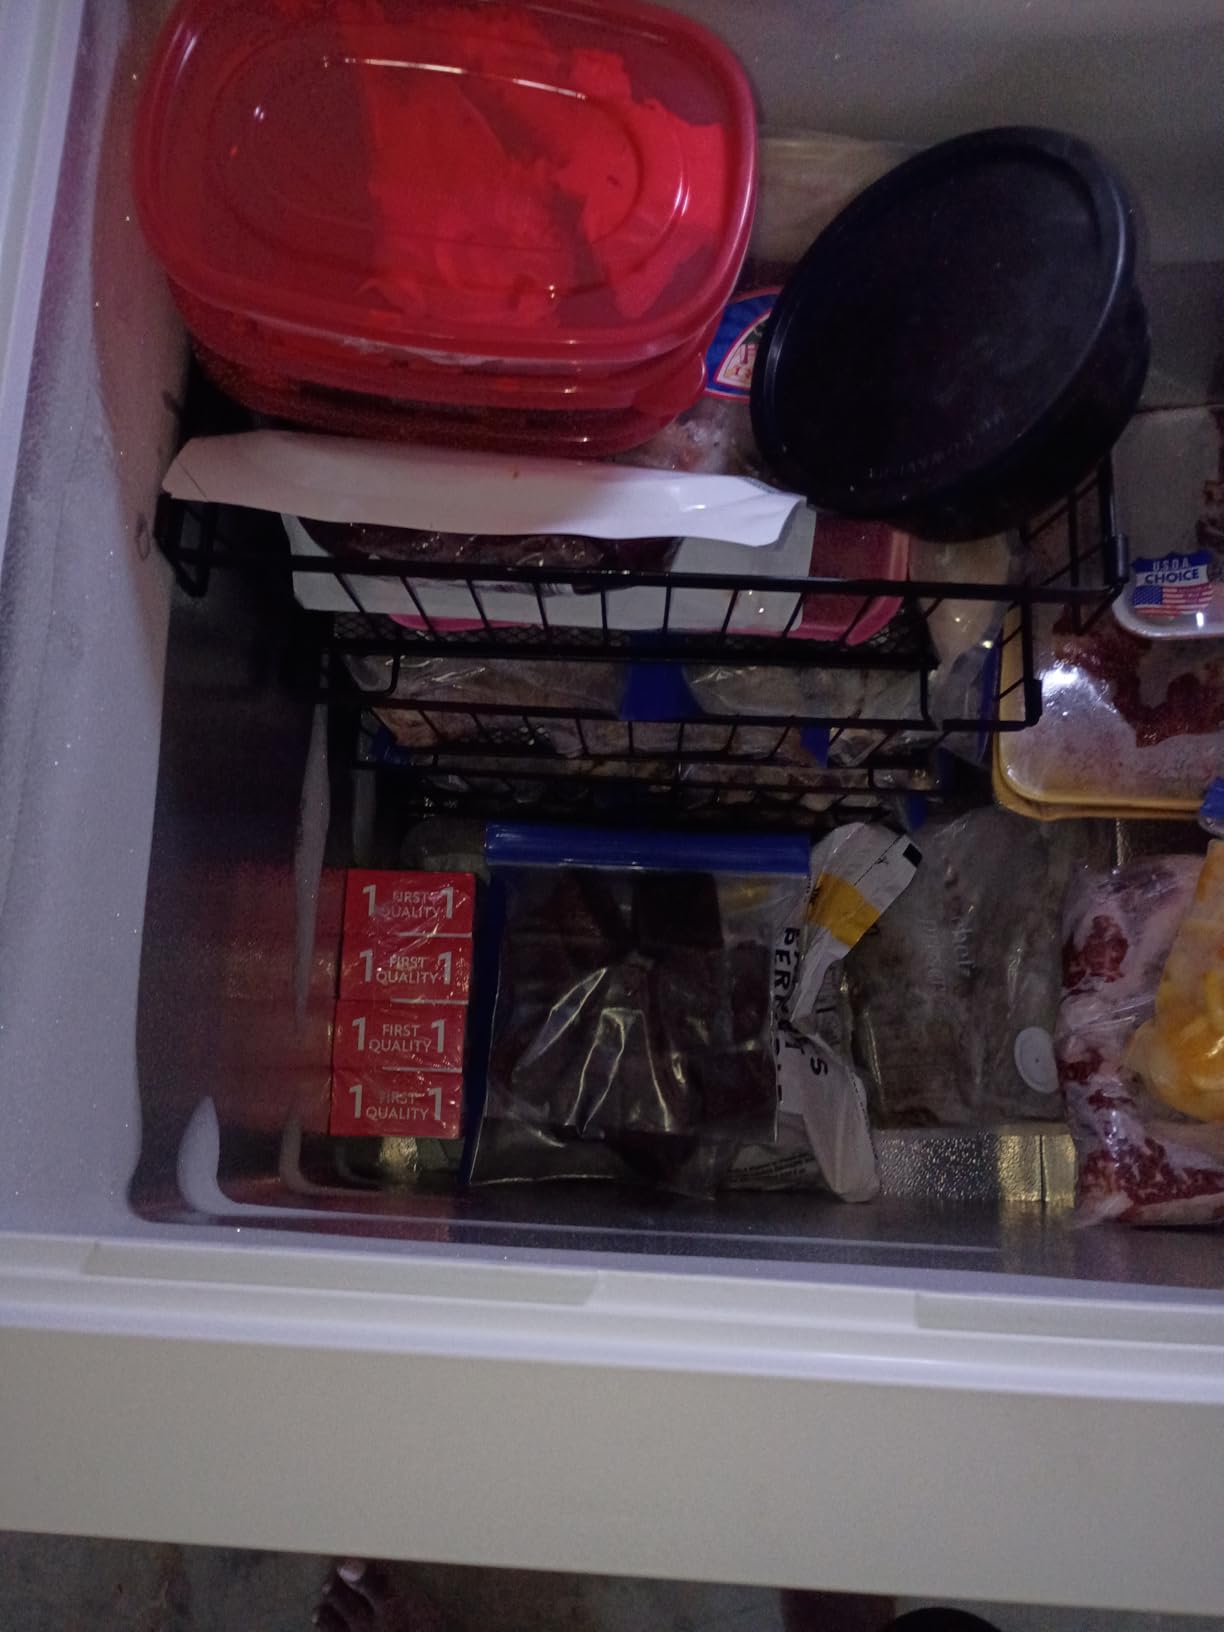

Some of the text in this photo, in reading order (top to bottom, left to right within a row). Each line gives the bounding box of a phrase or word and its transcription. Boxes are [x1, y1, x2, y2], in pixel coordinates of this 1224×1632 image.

[1145, 568, 1200, 584] CHOICE
[362, 884, 377, 917] 1
[392, 891, 430, 905] FIRST
[439, 886, 454, 920] 1
[359, 948, 374, 983] 1
[389, 956, 429, 970] FIRST
[438, 951, 453, 985] 1
[376, 970, 439, 985] QUALITY
[351, 1016, 367, 1052] 1
[382, 1023, 421, 1037] FIRST
[430, 1018, 446, 1054] 1
[368, 1038, 432, 1054] QUALITY
[348, 1084, 364, 1120] 1
[379, 1091, 418, 1105] FIRST
[427, 1087, 443, 1121] 1
[365, 1106, 430, 1121] QUALITY
